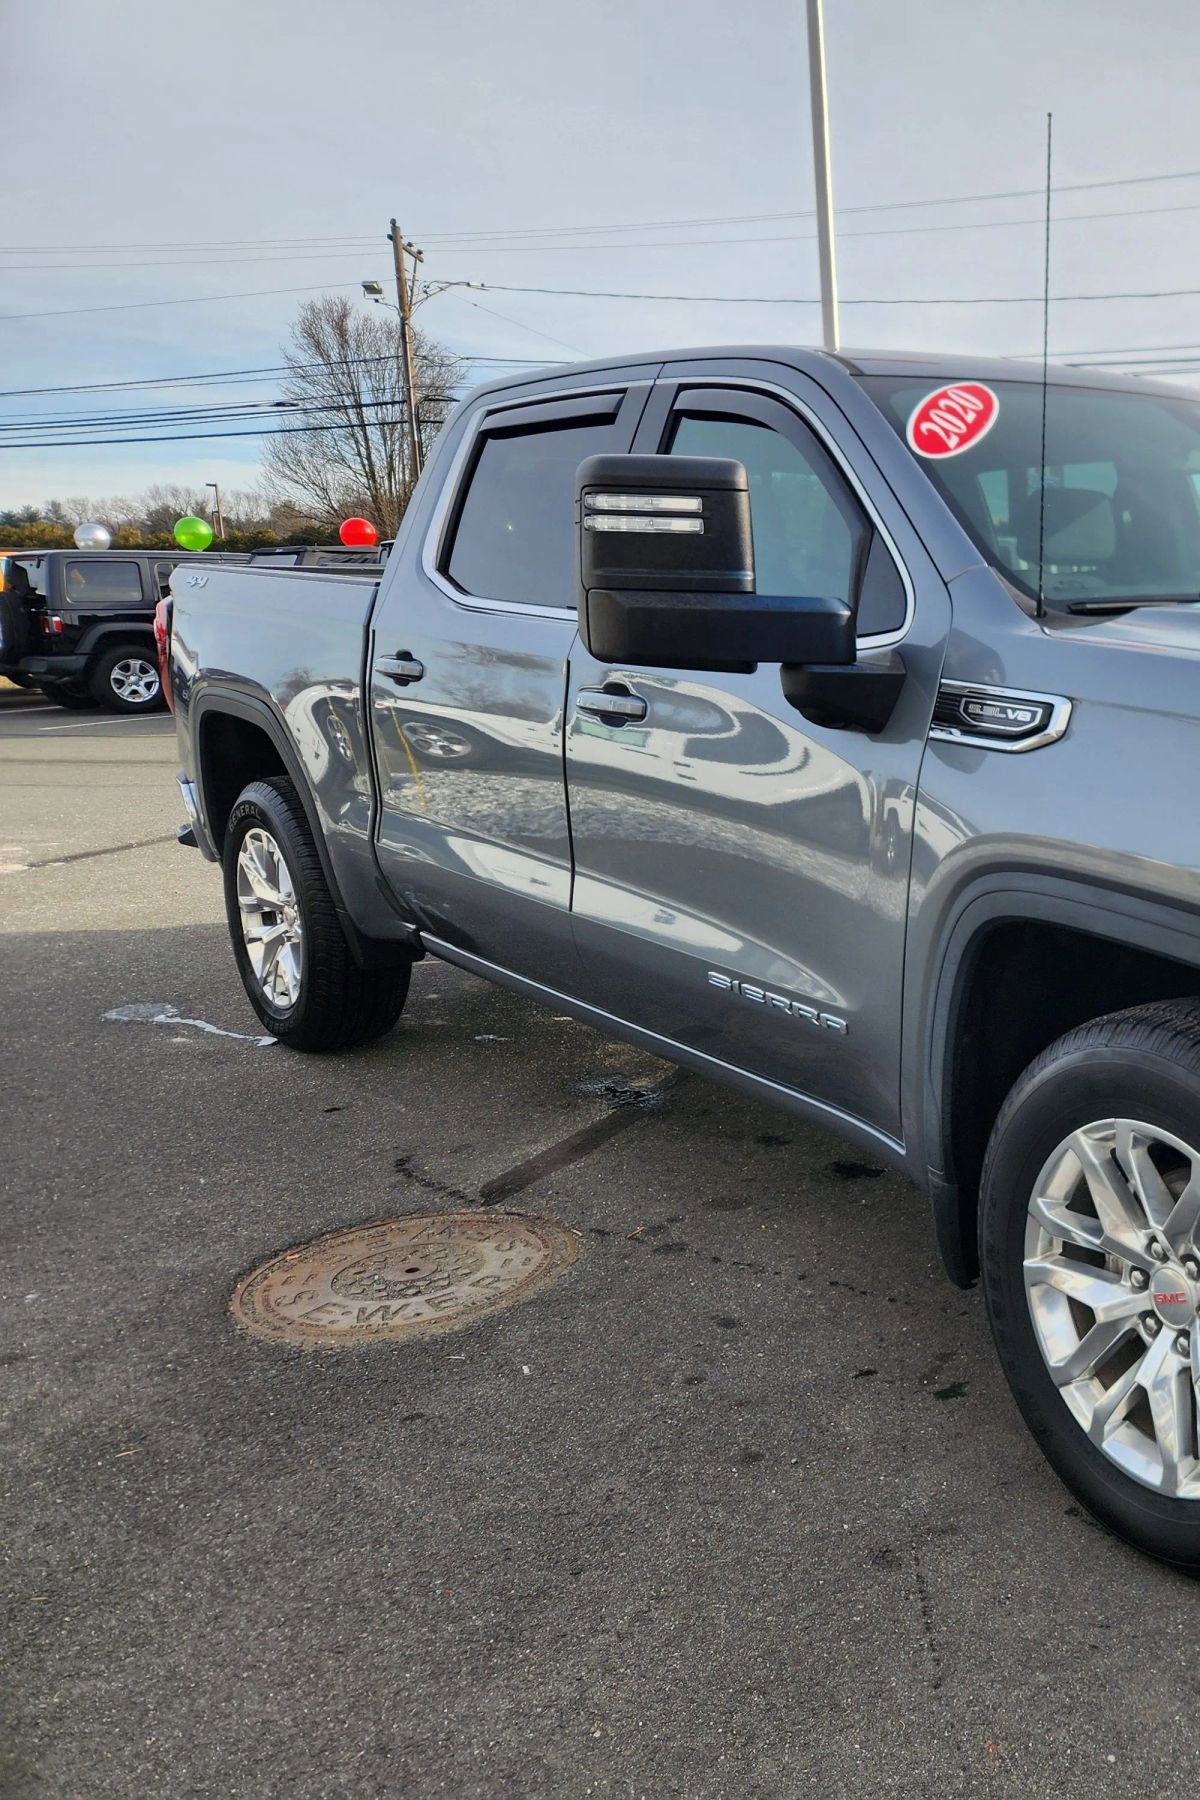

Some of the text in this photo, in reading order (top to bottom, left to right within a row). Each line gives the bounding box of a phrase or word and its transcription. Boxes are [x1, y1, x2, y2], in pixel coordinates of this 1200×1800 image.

[919, 388, 984, 450] 2020
[229, 804, 262, 833] GENERAL
[707, 970, 849, 1035] SIERRA
[1152, 1290, 1188, 1305] GMC
